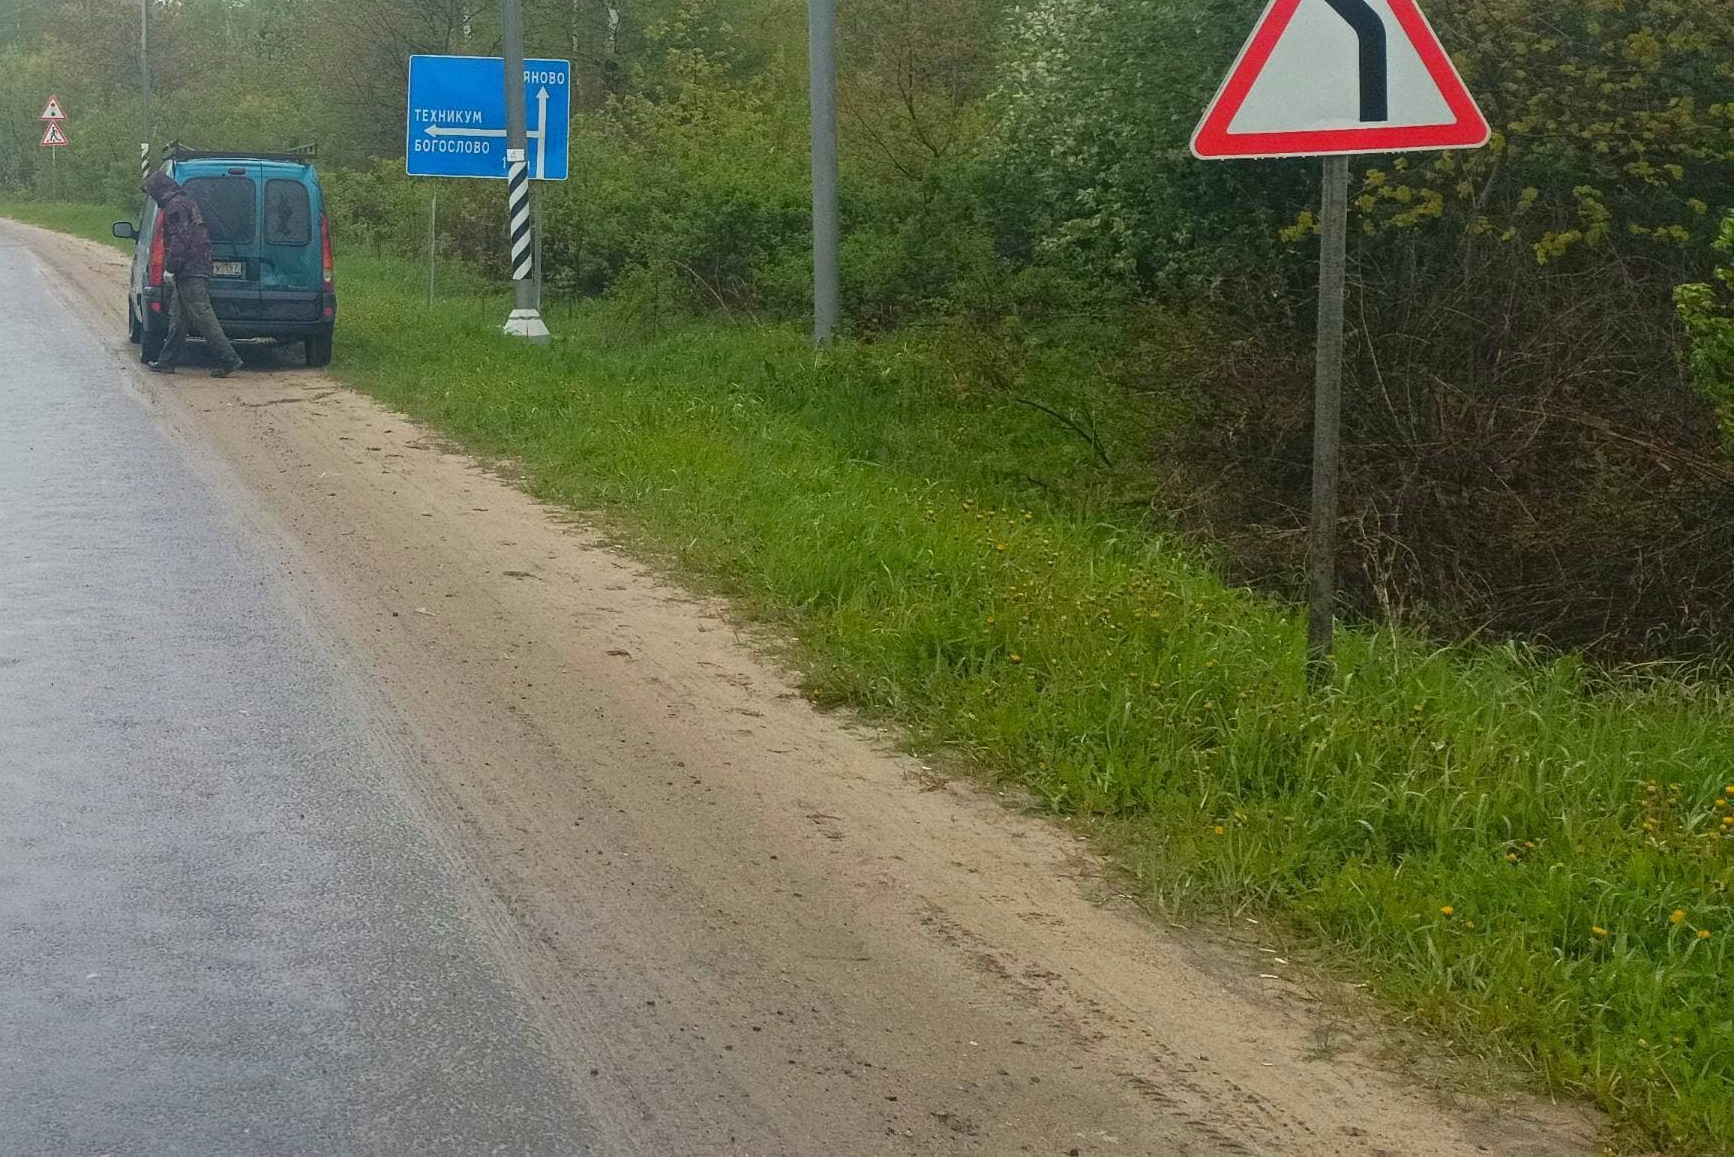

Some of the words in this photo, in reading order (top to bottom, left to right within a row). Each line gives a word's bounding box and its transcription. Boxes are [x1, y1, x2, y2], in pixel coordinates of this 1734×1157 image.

[524, 71, 566, 86] ЯНОВО
[415, 109, 483, 124] ТЕХНИКУМ
[414, 139, 490, 155] БОГОСЛОВО
